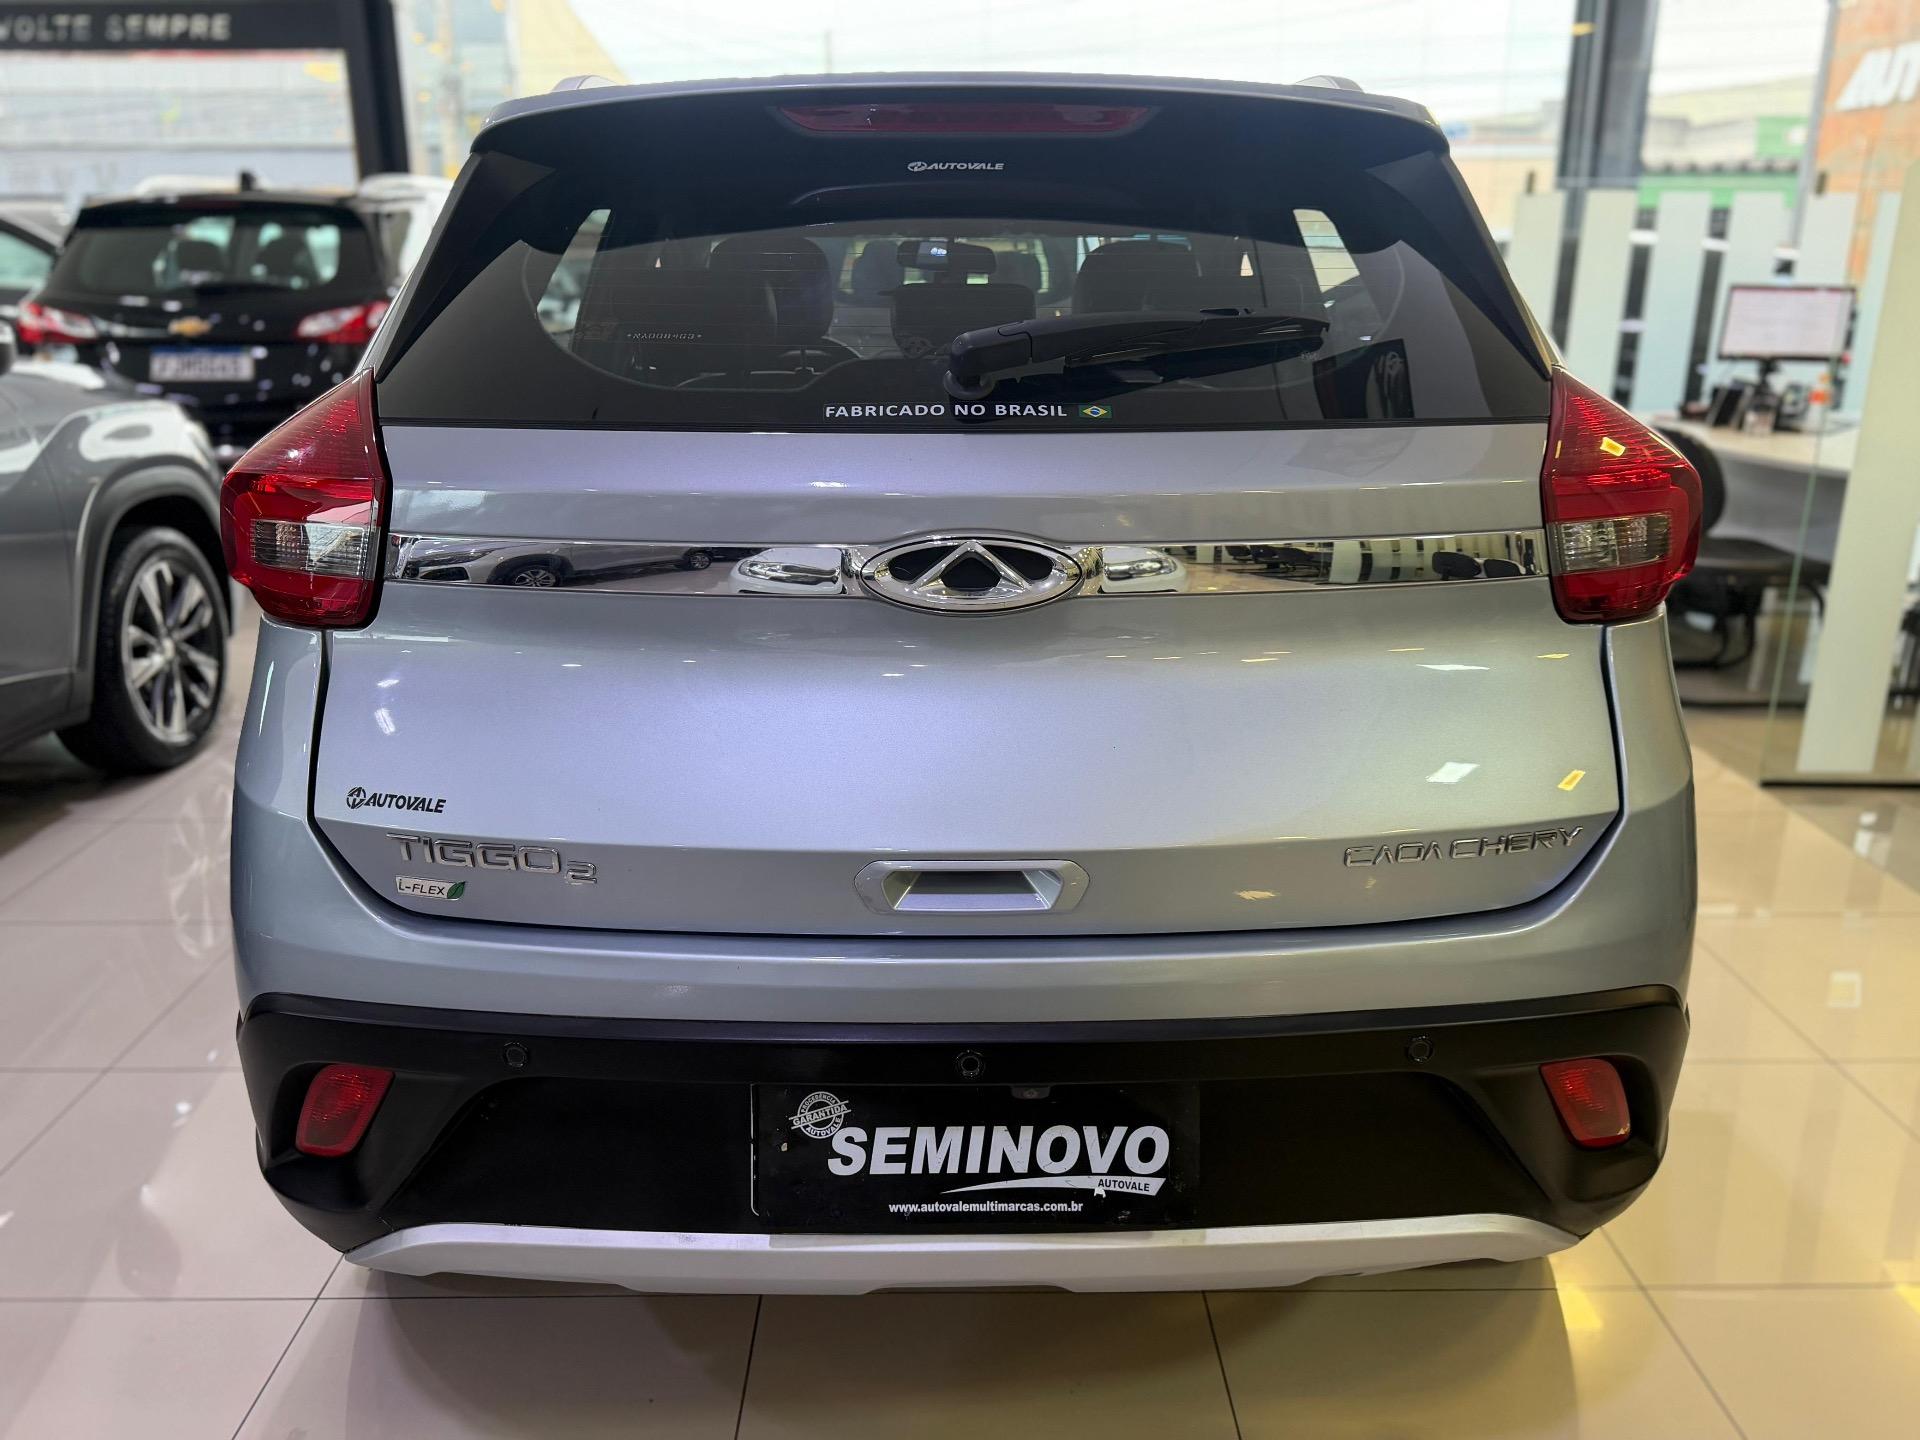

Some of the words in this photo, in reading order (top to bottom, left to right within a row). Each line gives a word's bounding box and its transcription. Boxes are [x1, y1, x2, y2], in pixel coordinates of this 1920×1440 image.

[104, 13, 231, 42] SEMPRE
[926, 162, 1004, 170] AUTOVALE
[825, 404, 945, 418] FABRICADO
[954, 404, 986, 416] NO
[995, 404, 1067, 417] BRASIL
[365, 792, 446, 813] AUTOVALE
[1344, 841, 1443, 868] CAOA
[1450, 826, 1584, 860] CHERY
[386, 832, 561, 874] TIGGO
[564, 860, 598, 886] 2
[792, 1104, 848, 1126] GARANTIDA
[805, 1116, 841, 1137] AUTOVALE
[827, 1125, 1170, 1176] SEMINOVO
[1097, 1178, 1150, 1192] AUTOVALE
[888, 1200, 1084, 1214] www.autovalemultimarcas.com.br
